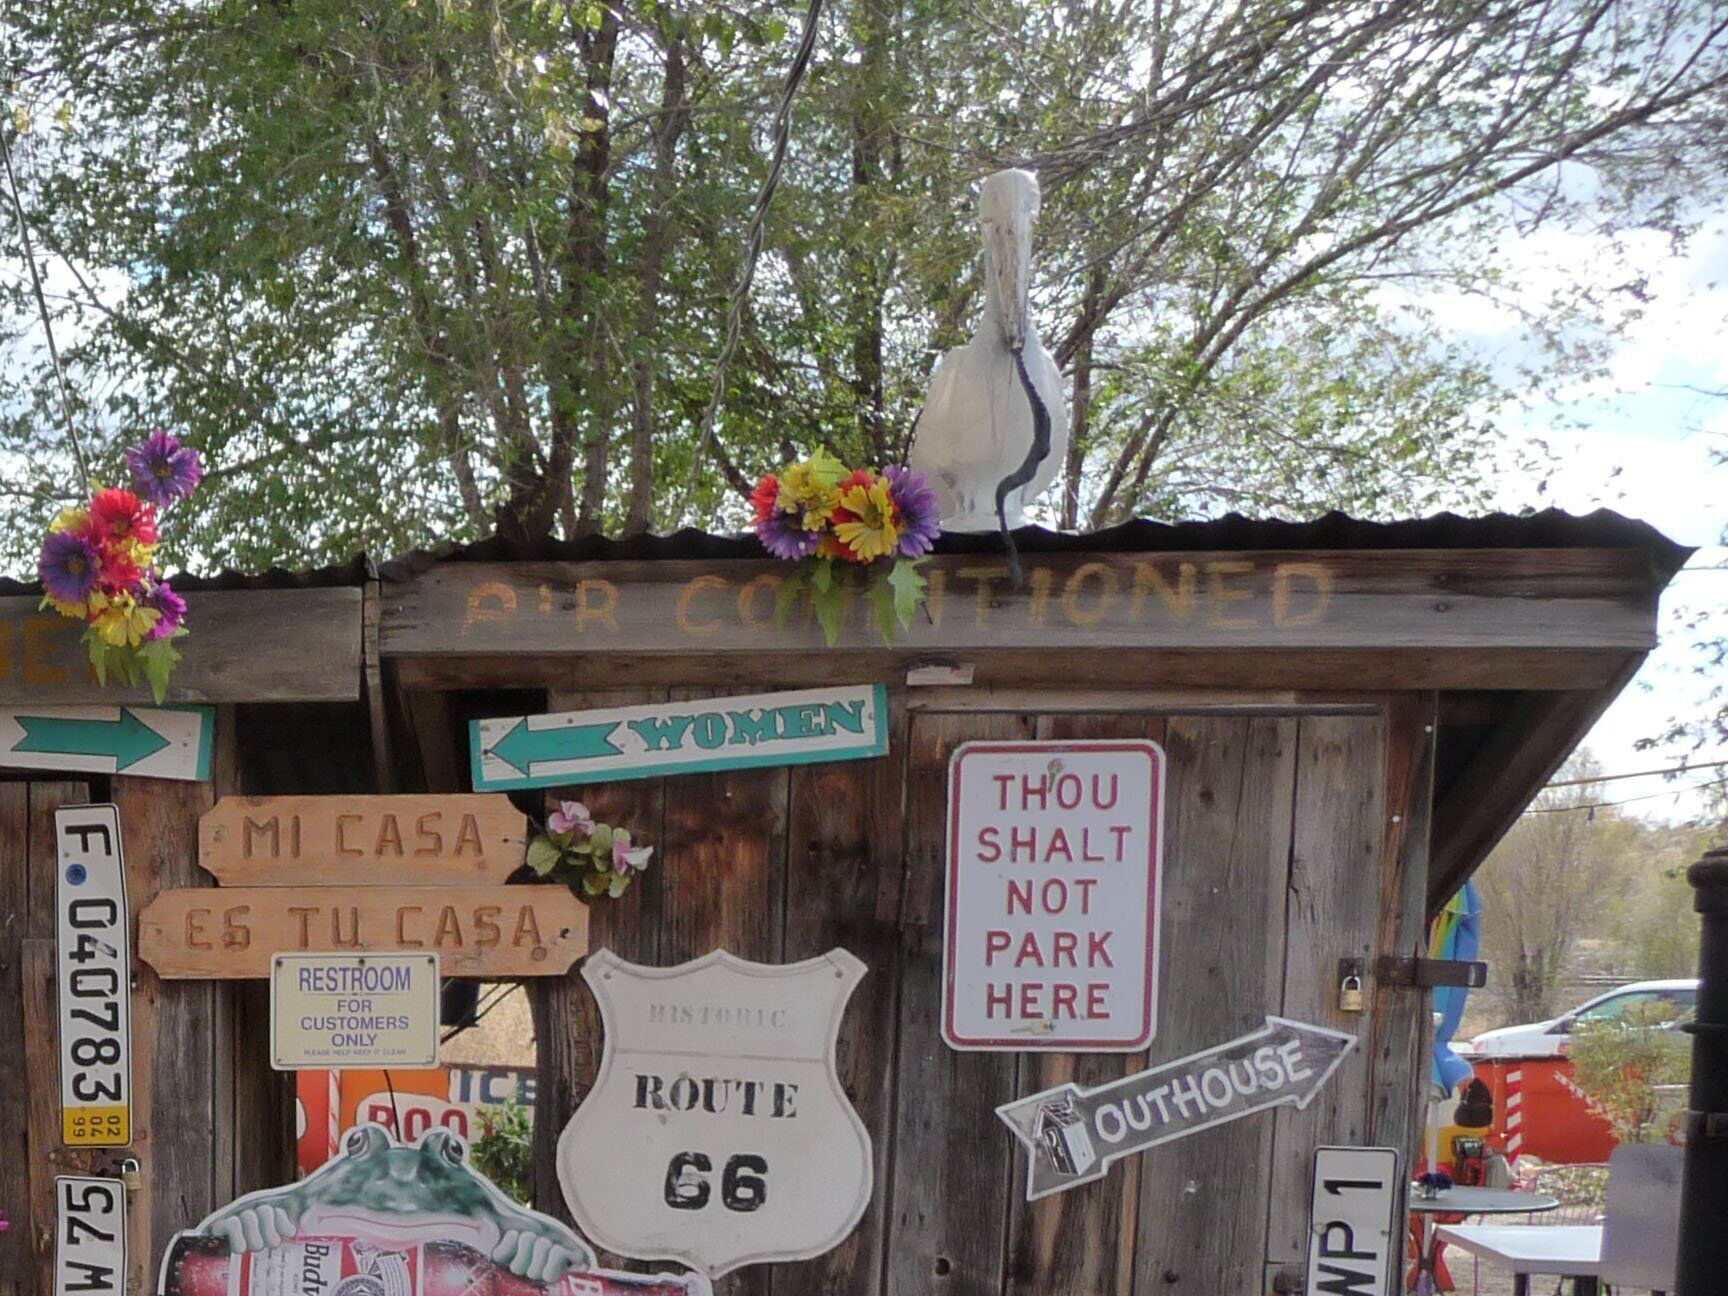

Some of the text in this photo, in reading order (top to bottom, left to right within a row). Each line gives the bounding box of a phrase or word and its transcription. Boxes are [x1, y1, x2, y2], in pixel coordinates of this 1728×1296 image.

[460, 562, 1334, 638] AIR COITIONED
[626, 699, 866, 753] WOMEN
[993, 773, 1119, 811] THOU
[64, 823, 112, 857] F
[241, 810, 485, 858] MI CASA
[976, 825, 1133, 863] SHALT
[1007, 877, 1098, 915] NOT
[184, 903, 544, 952] ES TU CASA
[984, 930, 1114, 968] PARK
[298, 965, 412, 992] RESTROOM
[337, 999, 373, 1013] FOR
[647, 1003, 788, 1029] HISTORIC
[985, 982, 1111, 1019] HERE
[300, 1015, 410, 1031] CUSTOMERS
[330, 1033, 379, 1048] ONLY
[632, 1073, 800, 1119] ROUTE
[1094, 1038, 1313, 1144] OUTHOUSE
[89, 1115, 104, 1139] 04
[105, 1114, 121, 1138] 02
[663, 1150, 770, 1213] 66
[65, 1184, 115, 1245] 75
